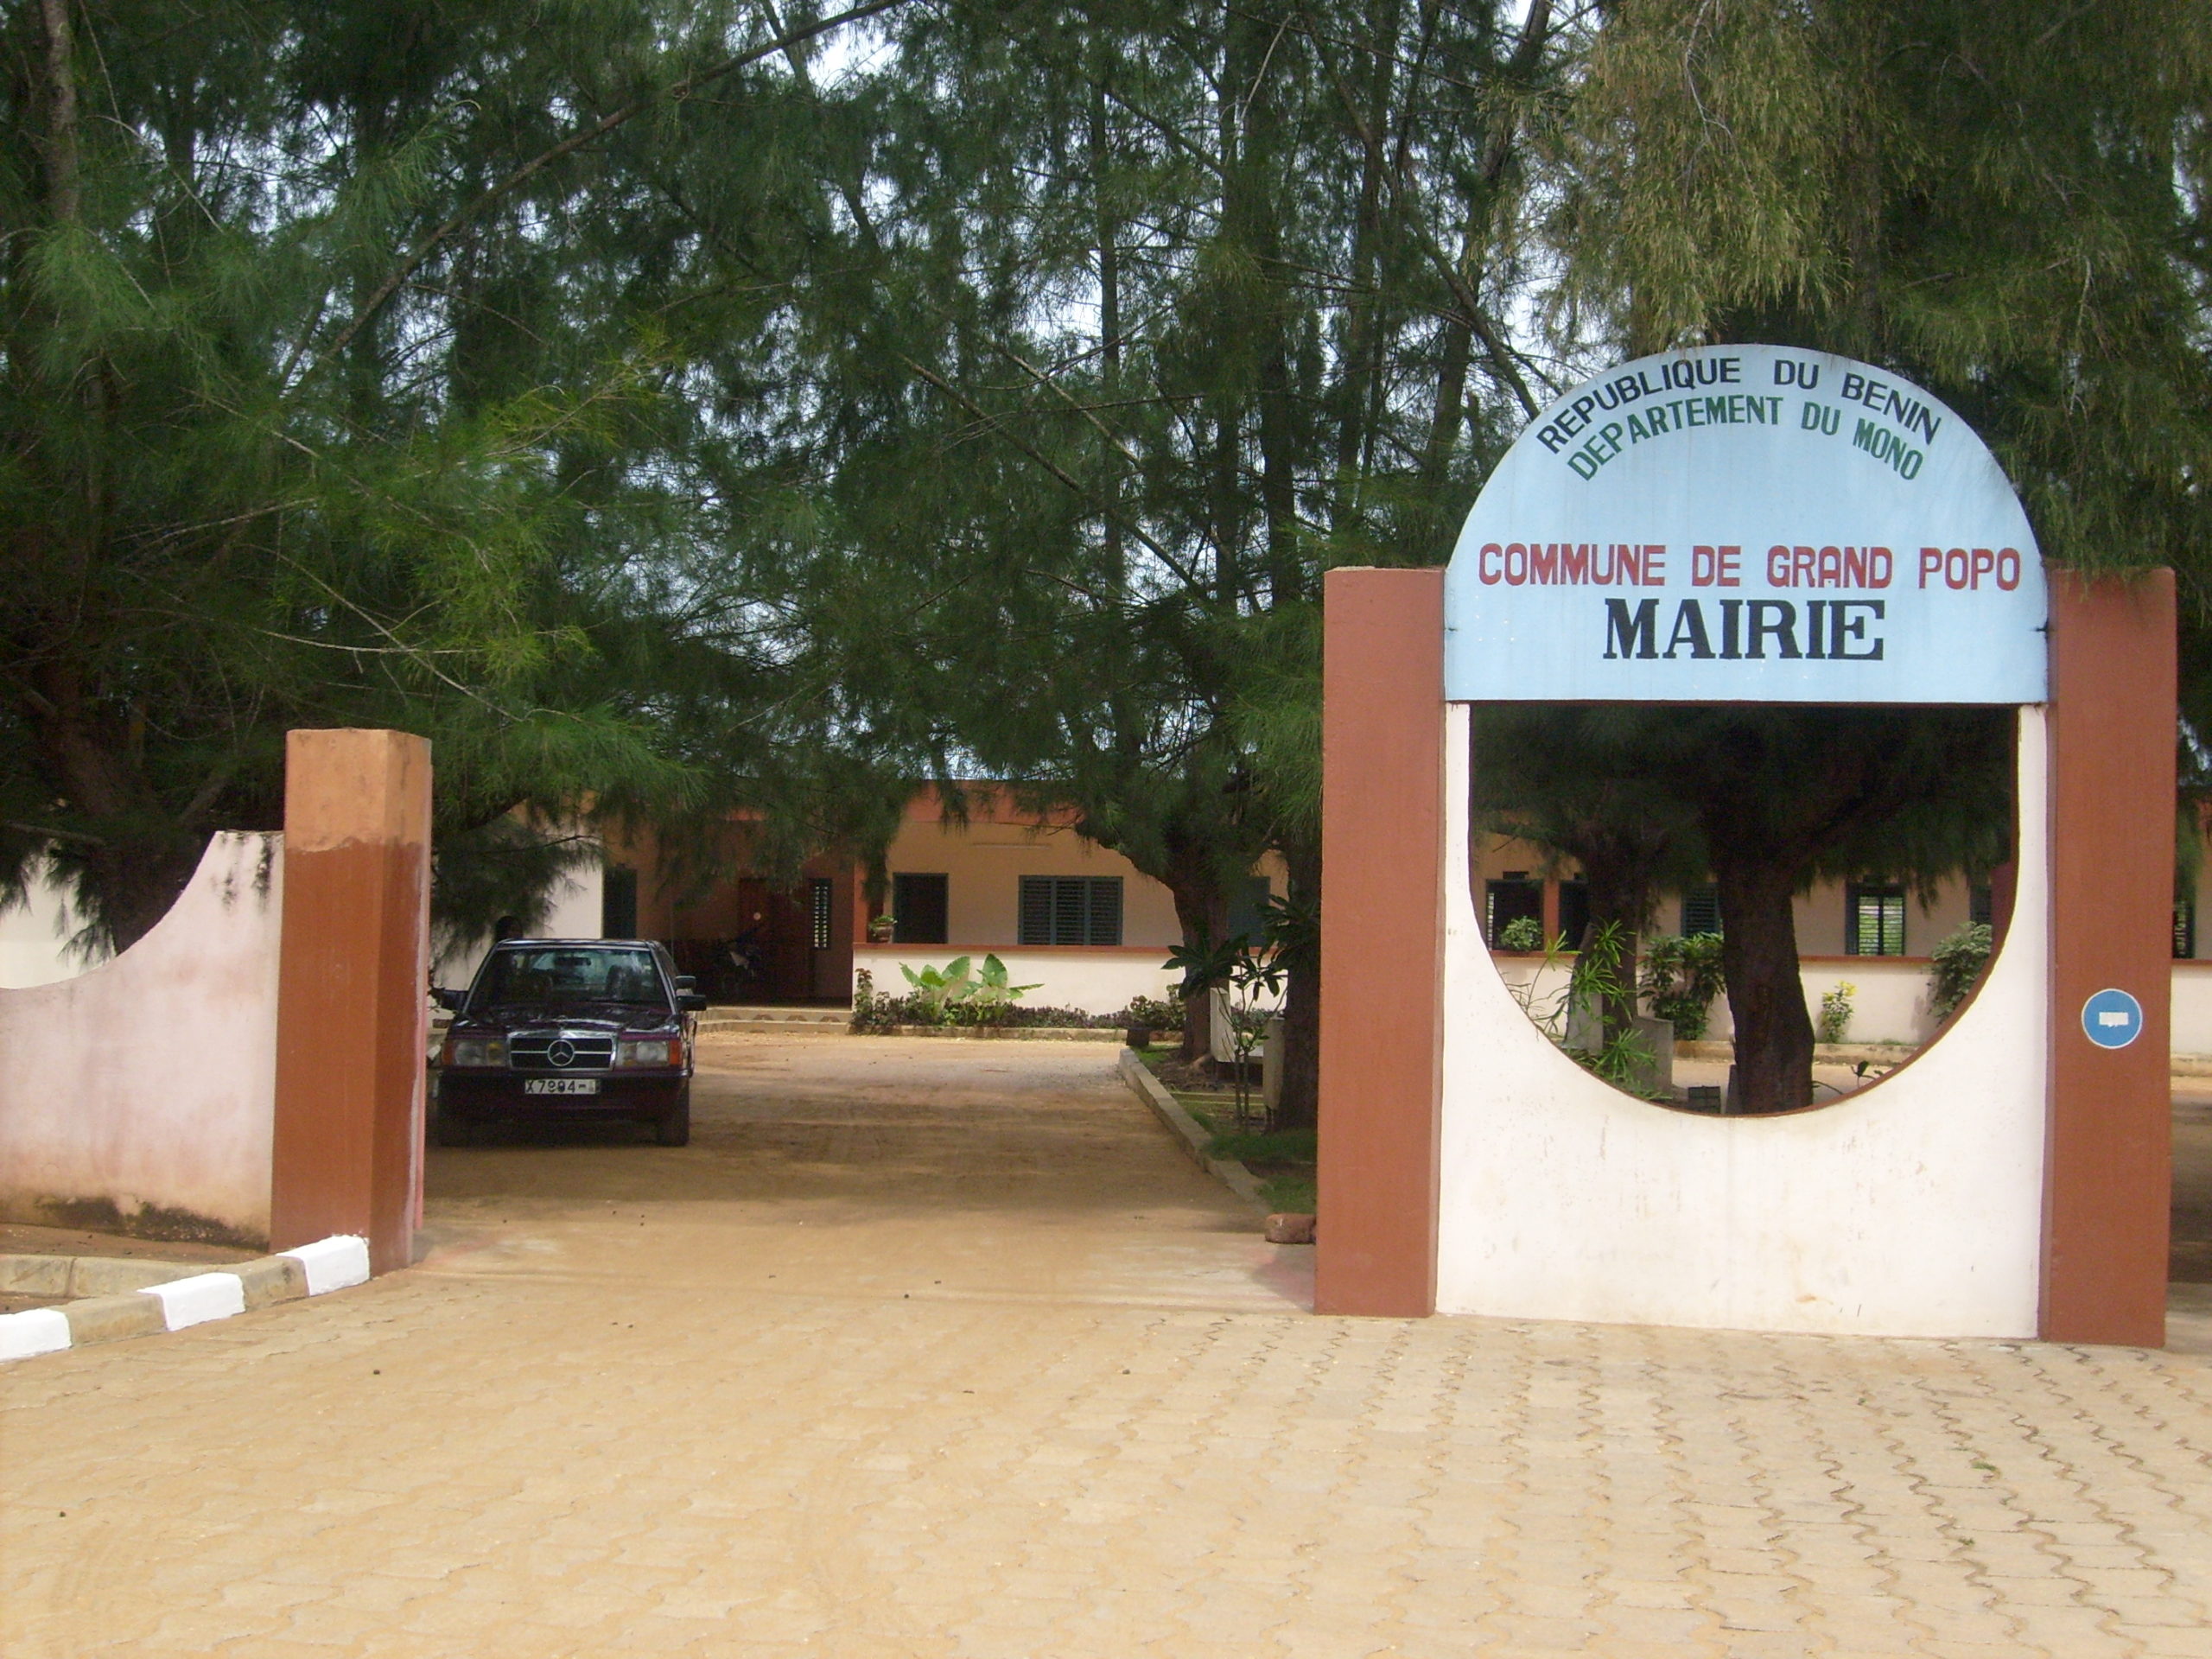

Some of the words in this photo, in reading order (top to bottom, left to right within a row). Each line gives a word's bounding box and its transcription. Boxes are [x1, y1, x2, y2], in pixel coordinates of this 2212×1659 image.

[1536, 358, 1740, 454] REPUBLIQUE
[1774, 359, 1819, 391] DU
[1841, 373, 1942, 445] BENIN
[1567, 395, 1783, 481] DEPARTEMENT
[1801, 402, 1840, 436] DU
[1853, 417, 1923, 480] MONO
[1478, 543, 1666, 587] COMMUNE
[1692, 545, 1740, 587] DE
[1766, 545, 1892, 589] GRAND
[1918, 547, 2020, 591] POPO
[1603, 598, 1885, 661] MAIRIE
